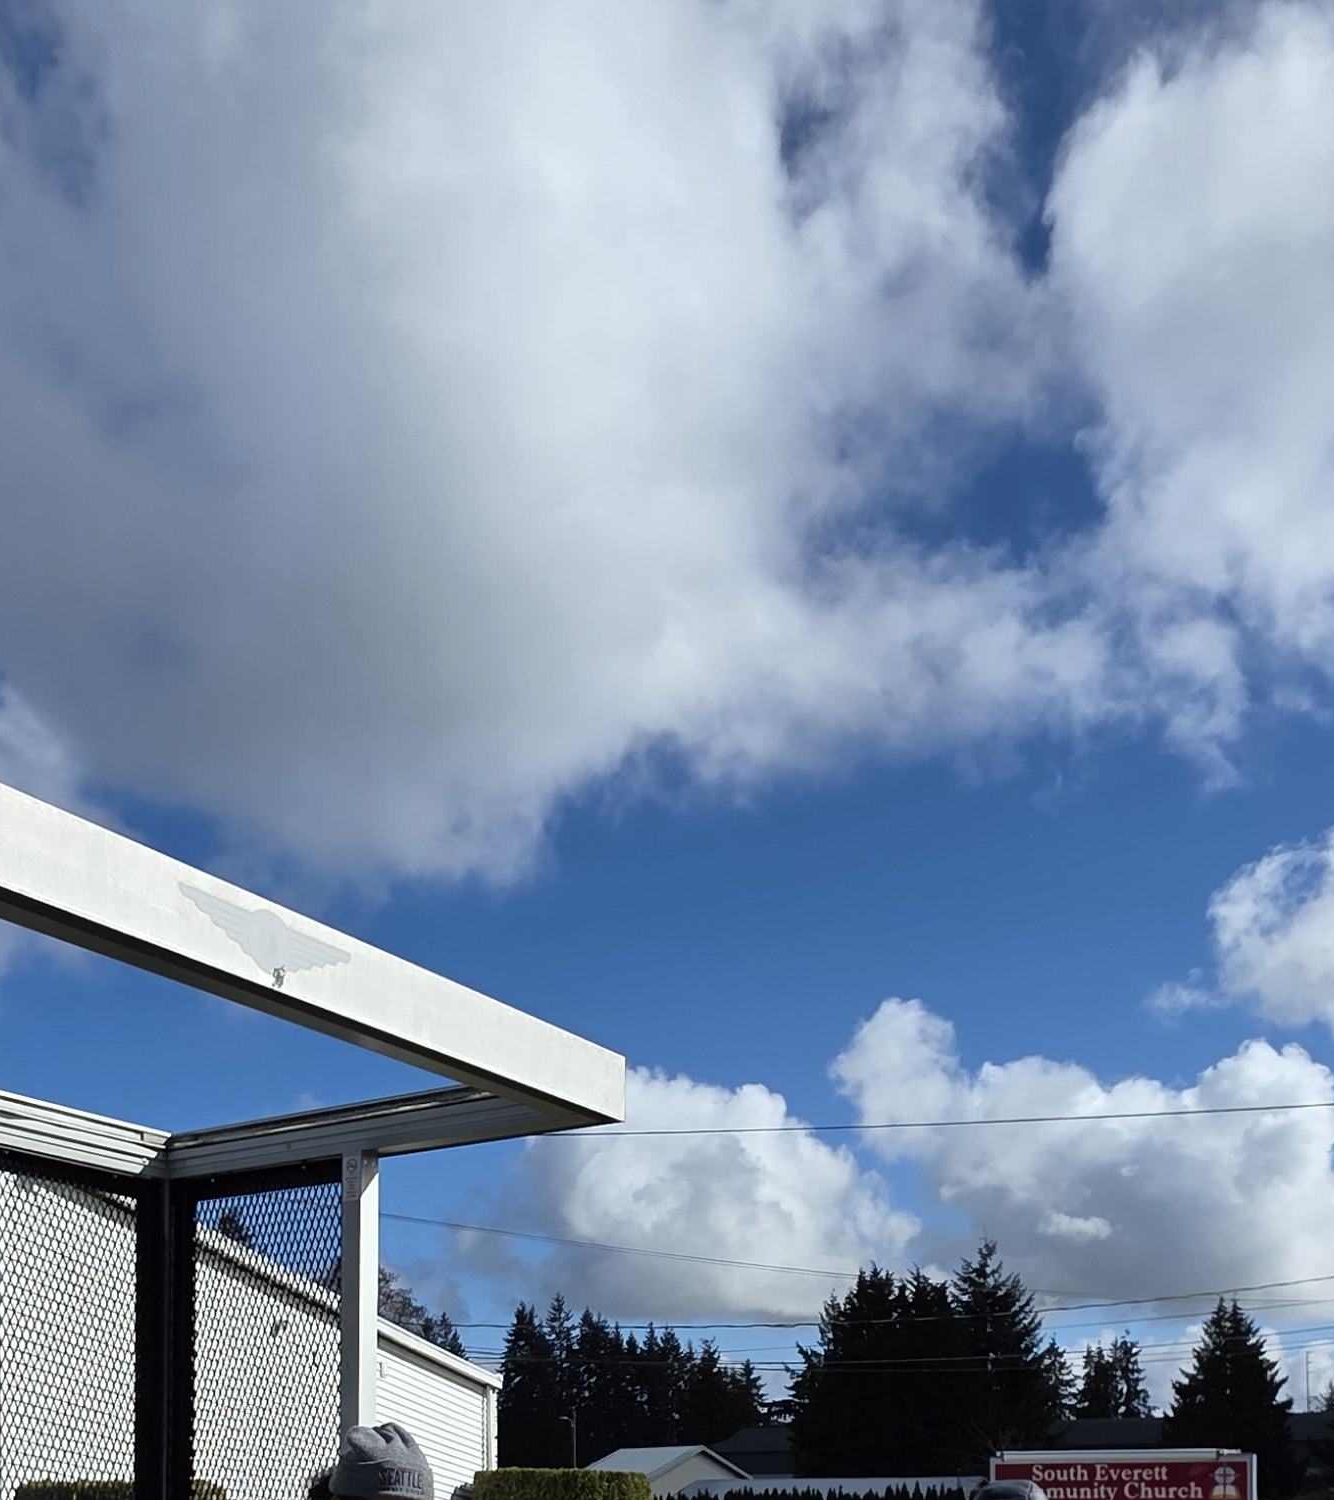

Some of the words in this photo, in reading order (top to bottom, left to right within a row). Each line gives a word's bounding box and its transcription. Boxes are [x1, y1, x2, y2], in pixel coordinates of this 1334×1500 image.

[380, 1468, 423, 1489] SEATTLE
[1032, 1464, 1089, 1481] South
[1094, 1464, 1168, 1481] Everett
[1123, 1481, 1203, 1500] Church
